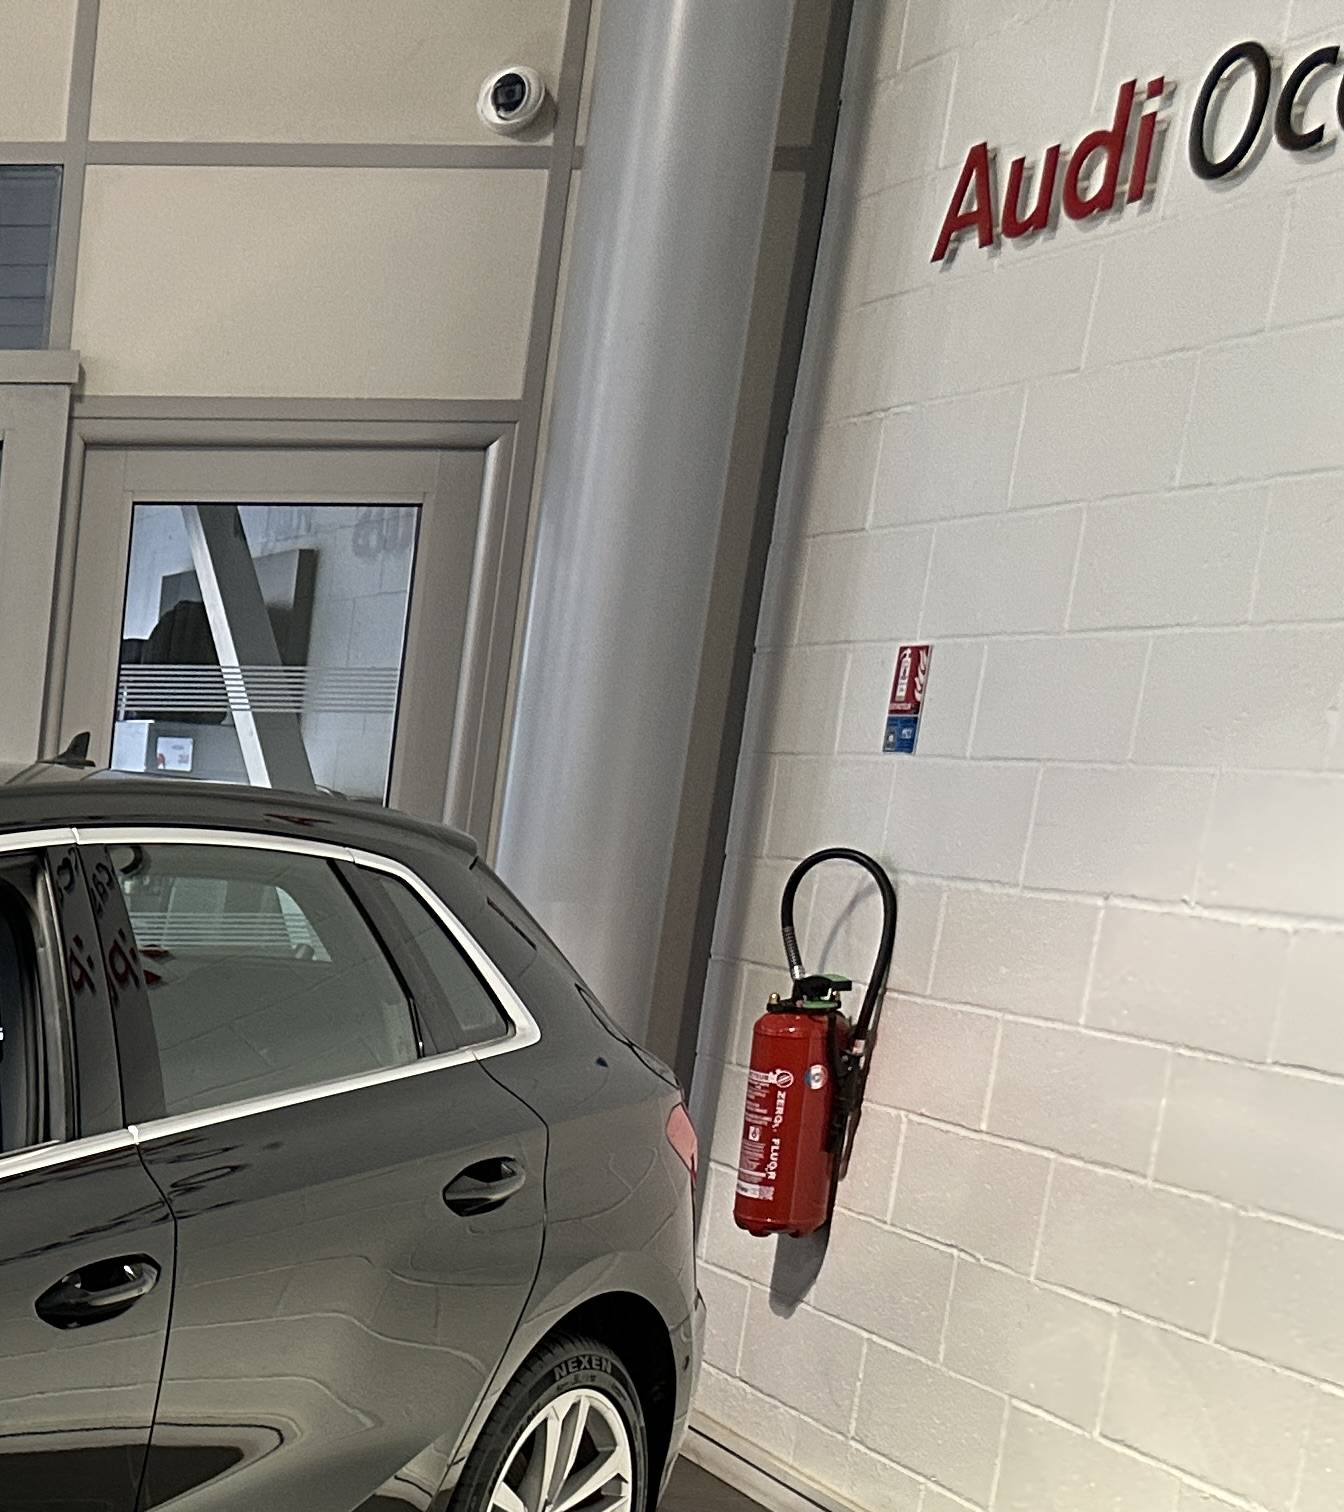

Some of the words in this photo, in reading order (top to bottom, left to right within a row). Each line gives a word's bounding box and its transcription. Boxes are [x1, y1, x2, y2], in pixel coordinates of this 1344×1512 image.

[930, 75, 1165, 263] Audi
[1188, 40, 1344, 181] Oc
[554, 1355, 612, 1381] NEXEN
